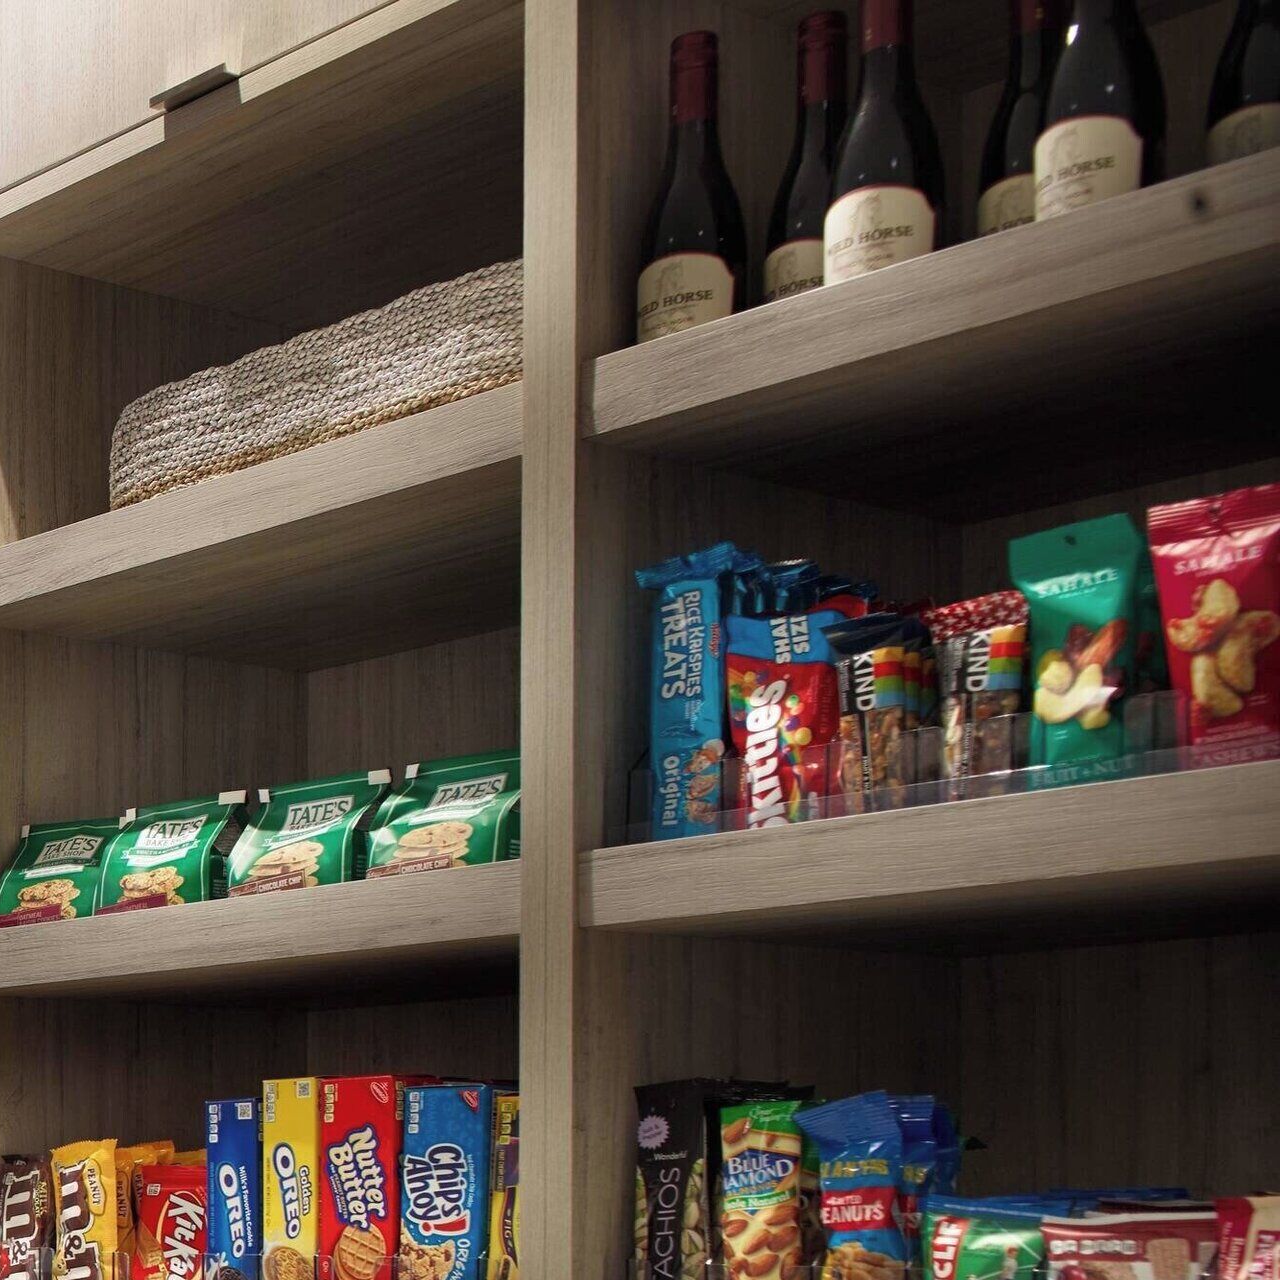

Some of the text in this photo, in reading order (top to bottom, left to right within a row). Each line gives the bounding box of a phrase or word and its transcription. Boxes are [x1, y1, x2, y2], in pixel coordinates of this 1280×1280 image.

[1057, 156, 1115, 181] HORSE
[858, 226, 913, 244] HORSE
[663, 290, 713, 306] HORSE
[1174, 545, 1263, 576] SAHALE
[661, 596, 687, 699] TREATS
[684, 591, 703, 697] RICE KRISPIES
[770, 616, 791, 664] SHA
[790, 615, 810, 654] SIZ
[966, 632, 990, 691] KIND
[853, 651, 875, 711] KIND
[439, 779, 501, 801] TATE'S
[145, 819, 202, 840] TATE'S
[289, 799, 349, 826] TATE'S
[44, 837, 98, 856] TATE'S
[401, 859, 434, 874] CHOCOLATE
[434, 856, 450, 867] CHIP
[259, 878, 288, 893] CHOCOLATE
[288, 875, 302, 885] CHIP
[348, 1126, 385, 1218] Nutter
[426, 1143, 468, 1219] Chips
[724, 1159, 794, 1190] IAMOND
[728, 1155, 770, 1176] BLUE
[820, 1159, 888, 1178] LANTERS
[87, 1168, 101, 1206] PEANUT
[117, 1180, 127, 1218] PEANUT
[241, 1189, 252, 1222] Favorite
[274, 1143, 301, 1239] OREO
[299, 1165, 311, 1216] Golden
[328, 1142, 368, 1232] Butter
[404, 1154, 470, 1236] Ahoy!
[218, 1162, 245, 1258] OREO
[245, 1221, 254, 1248] Cookie
[933, 1219, 963, 1279] CLIF
